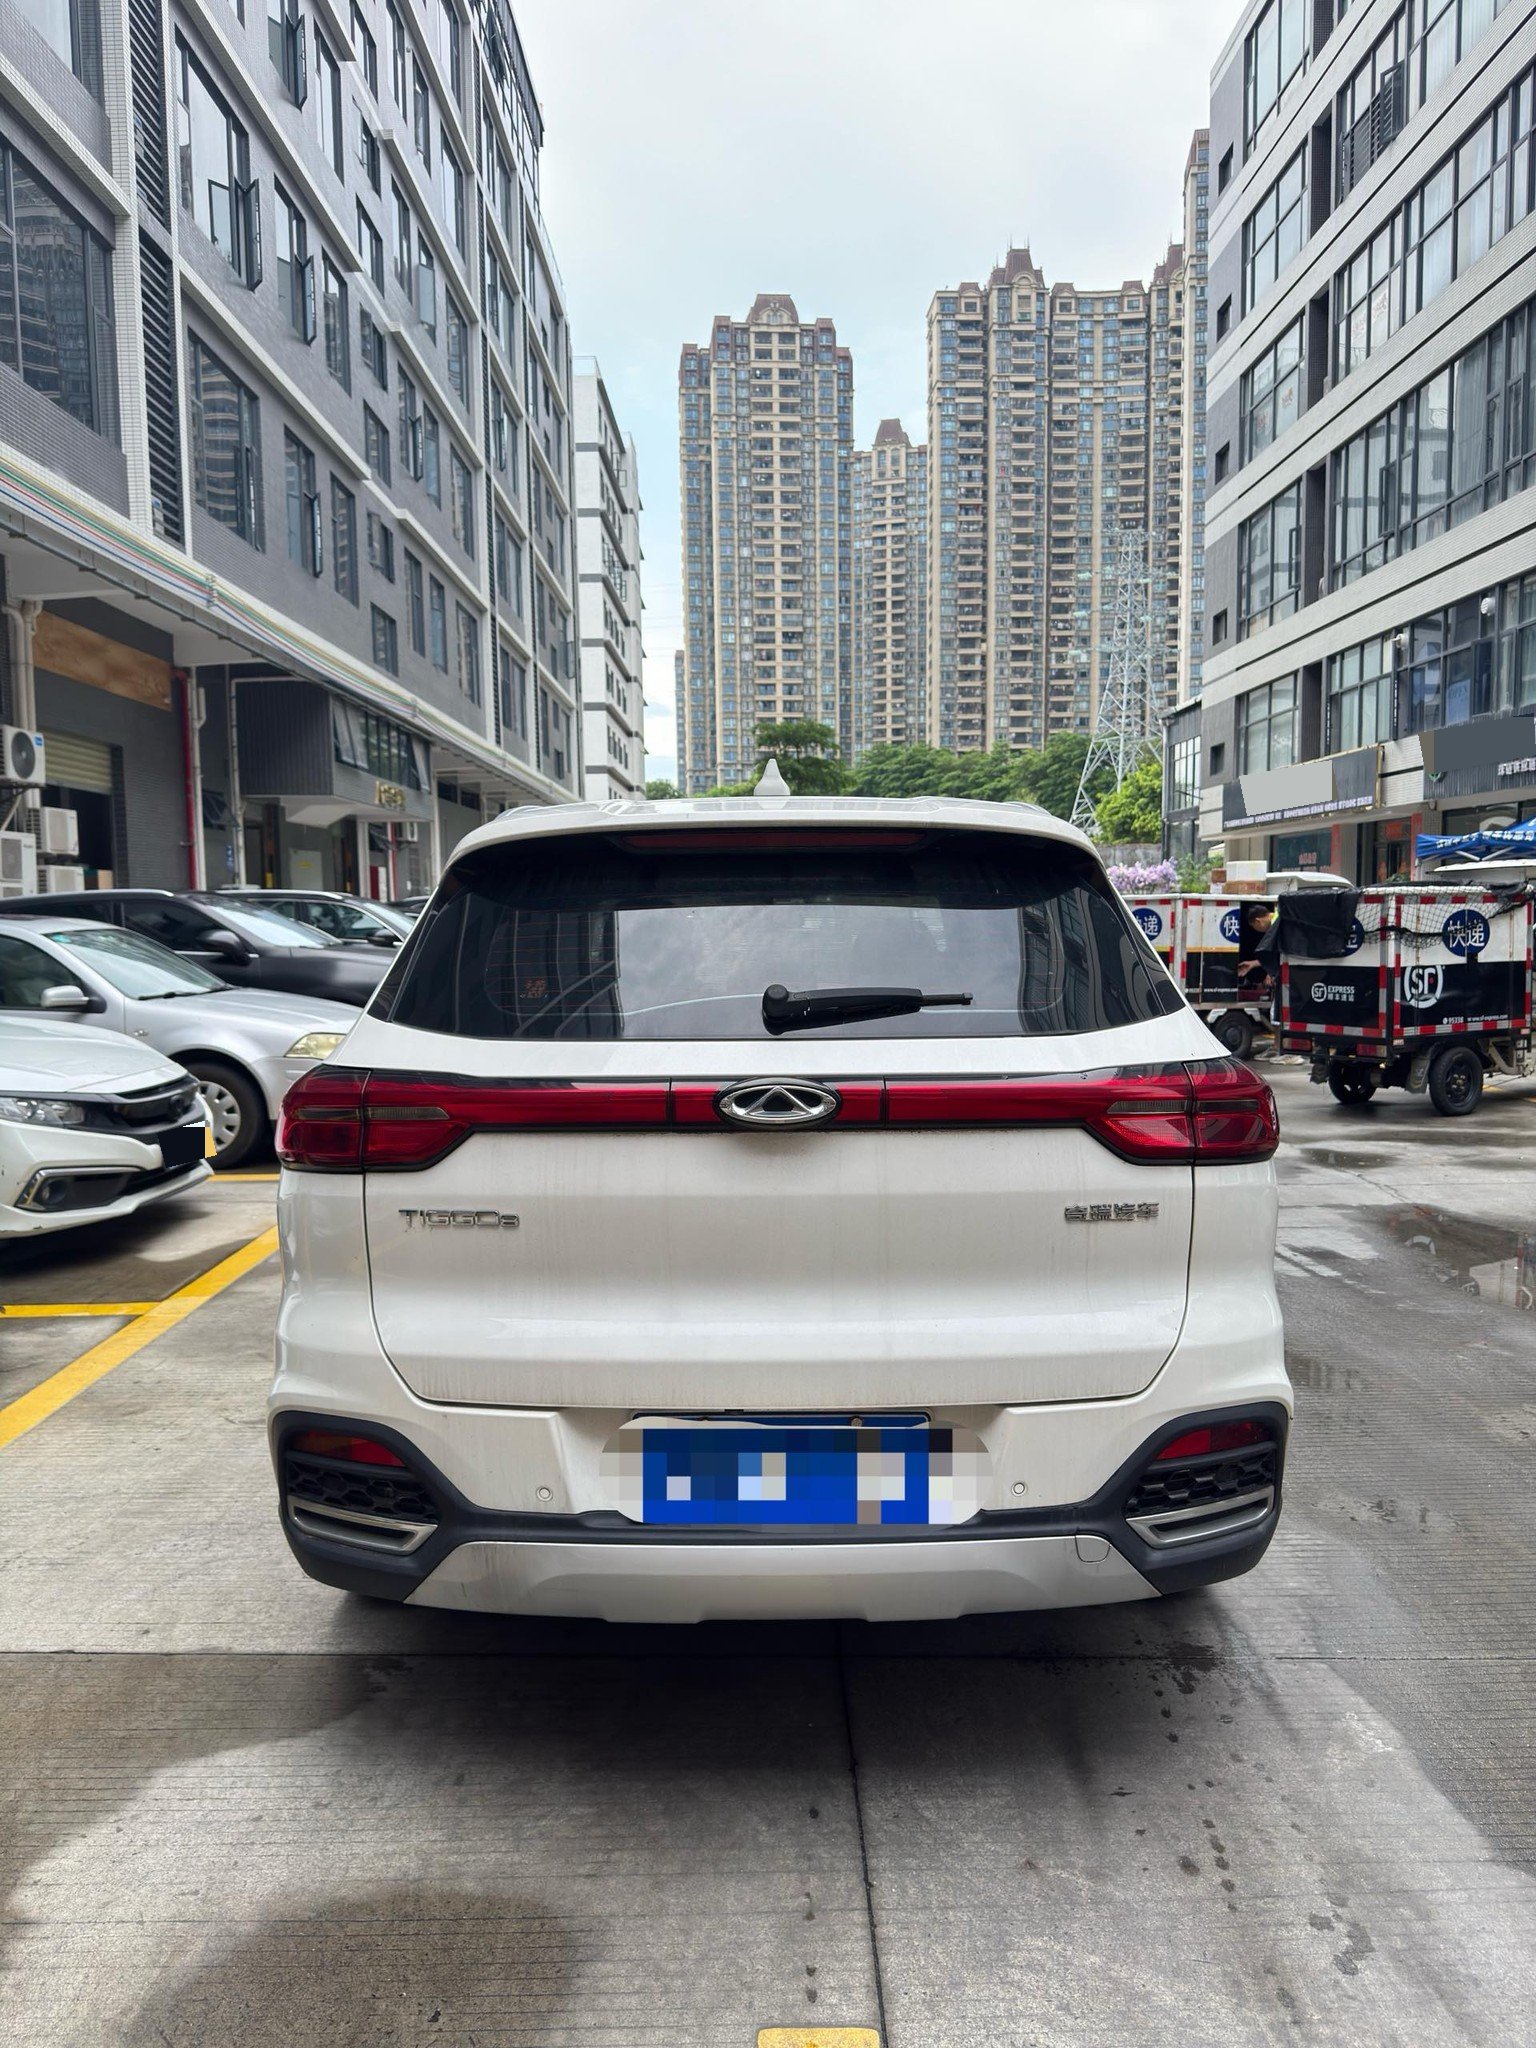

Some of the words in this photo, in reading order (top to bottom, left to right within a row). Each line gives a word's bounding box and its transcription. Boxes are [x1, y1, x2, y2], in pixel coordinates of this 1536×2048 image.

[1223, 916, 1240, 937] 快
[1447, 920, 1485, 948] 快递
[1327, 985, 1355, 994] EXPRESS
[1064, 1202, 1160, 1221] 奇瑞汽车
